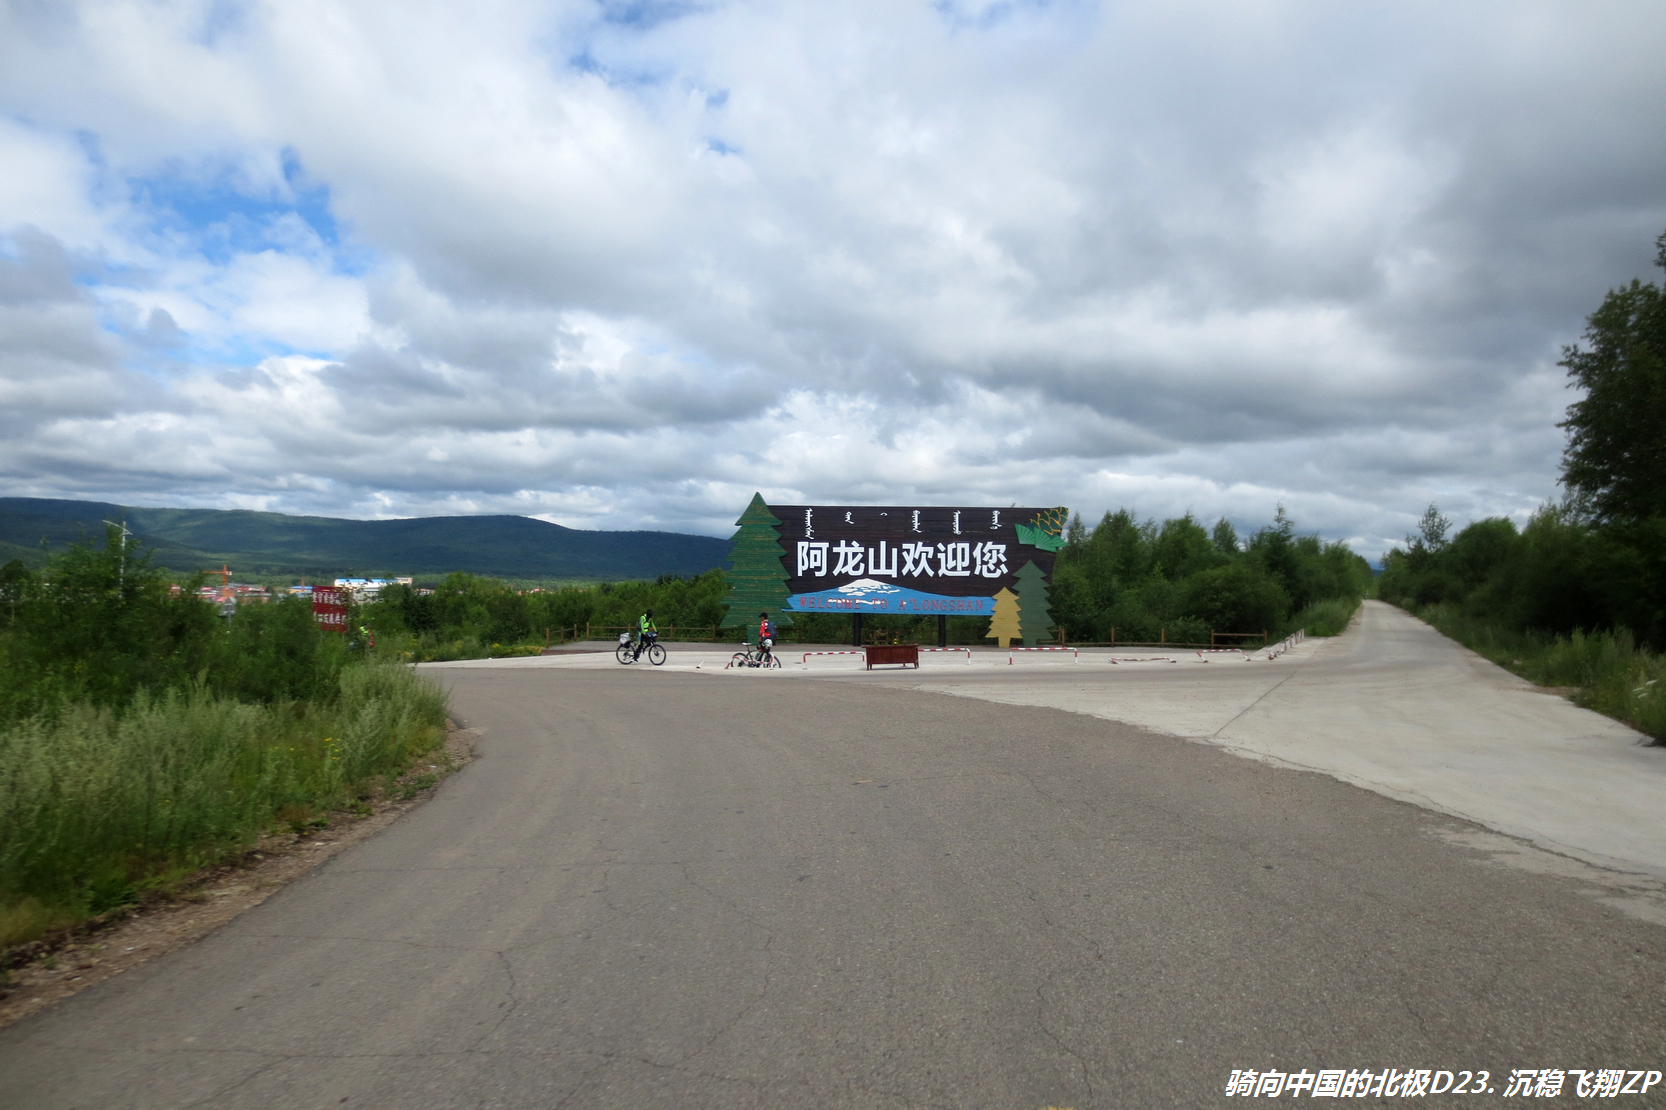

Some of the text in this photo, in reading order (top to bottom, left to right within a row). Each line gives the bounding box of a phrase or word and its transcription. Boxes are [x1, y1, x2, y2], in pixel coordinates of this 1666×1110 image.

[797, 539, 1009, 579] 阿龙山欢迎您
[799, 596, 861, 610] WELCOME
[872, 598, 889, 610] TO
